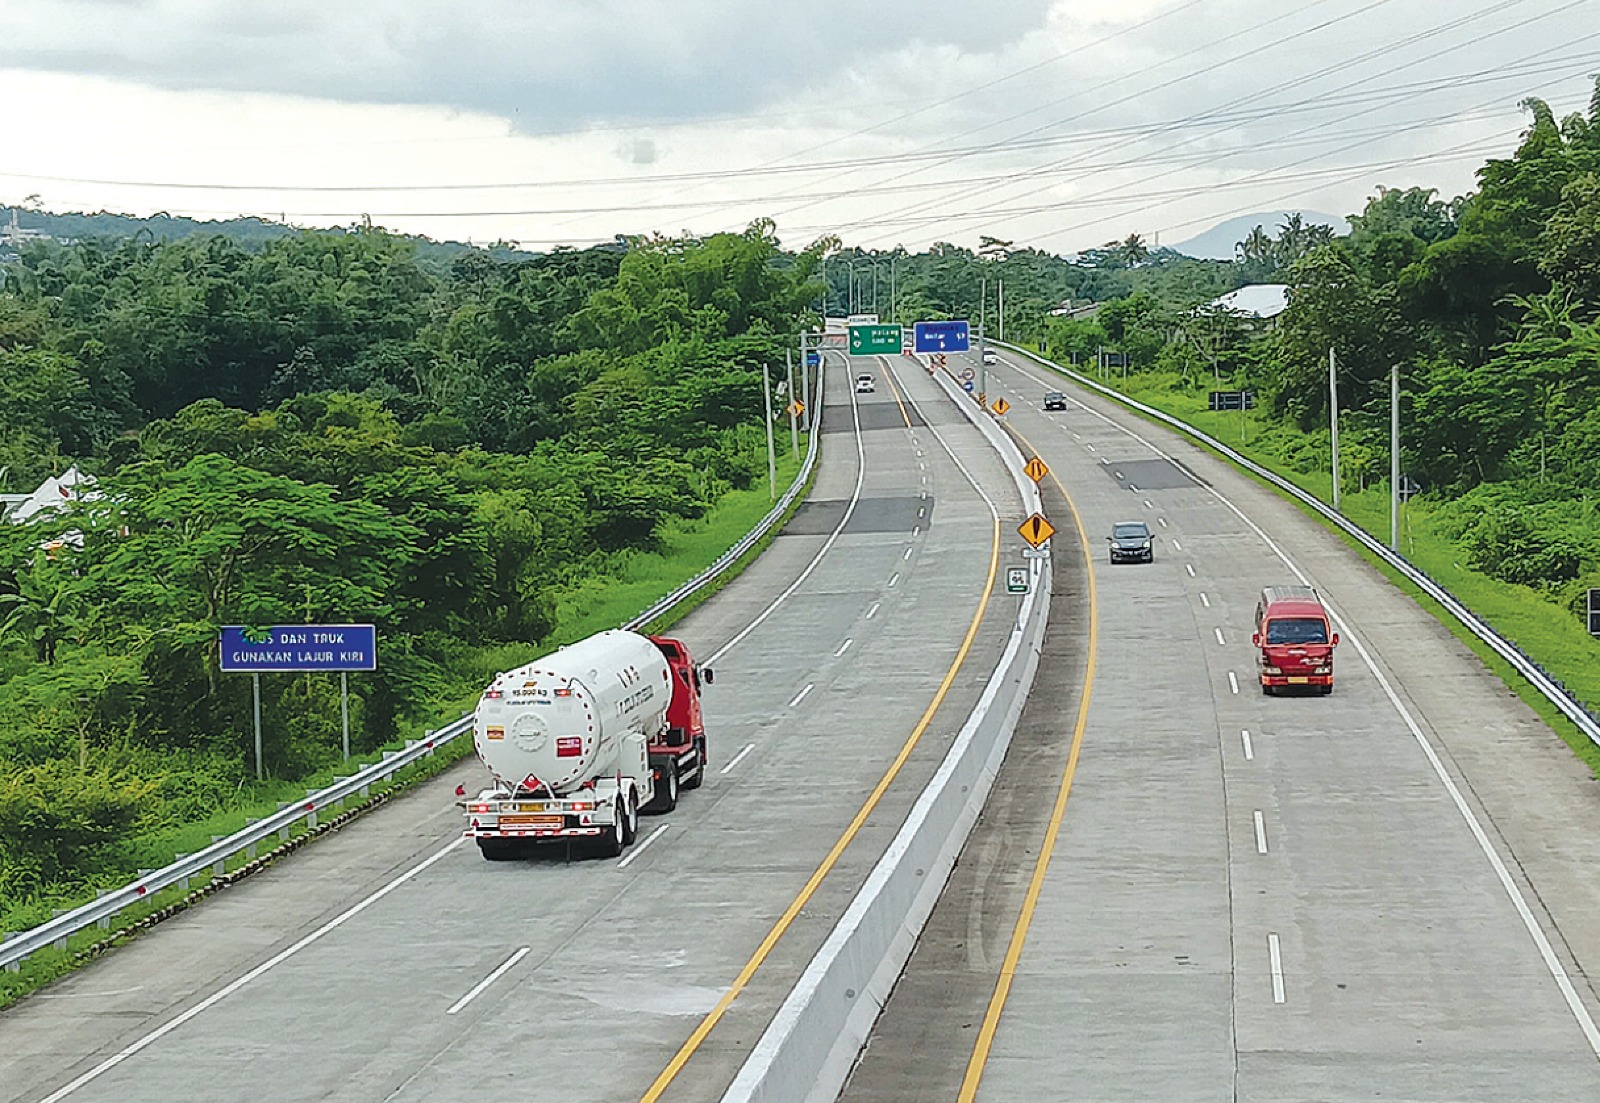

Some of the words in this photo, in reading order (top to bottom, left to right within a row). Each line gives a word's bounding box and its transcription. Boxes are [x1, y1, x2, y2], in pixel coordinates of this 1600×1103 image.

[280, 633, 307, 644] DAN
[312, 633, 345, 644] TRUK
[232, 651, 292, 663] GUNAKAN
[297, 651, 334, 662] LAJUR
[340, 651, 363, 662] KIRI
